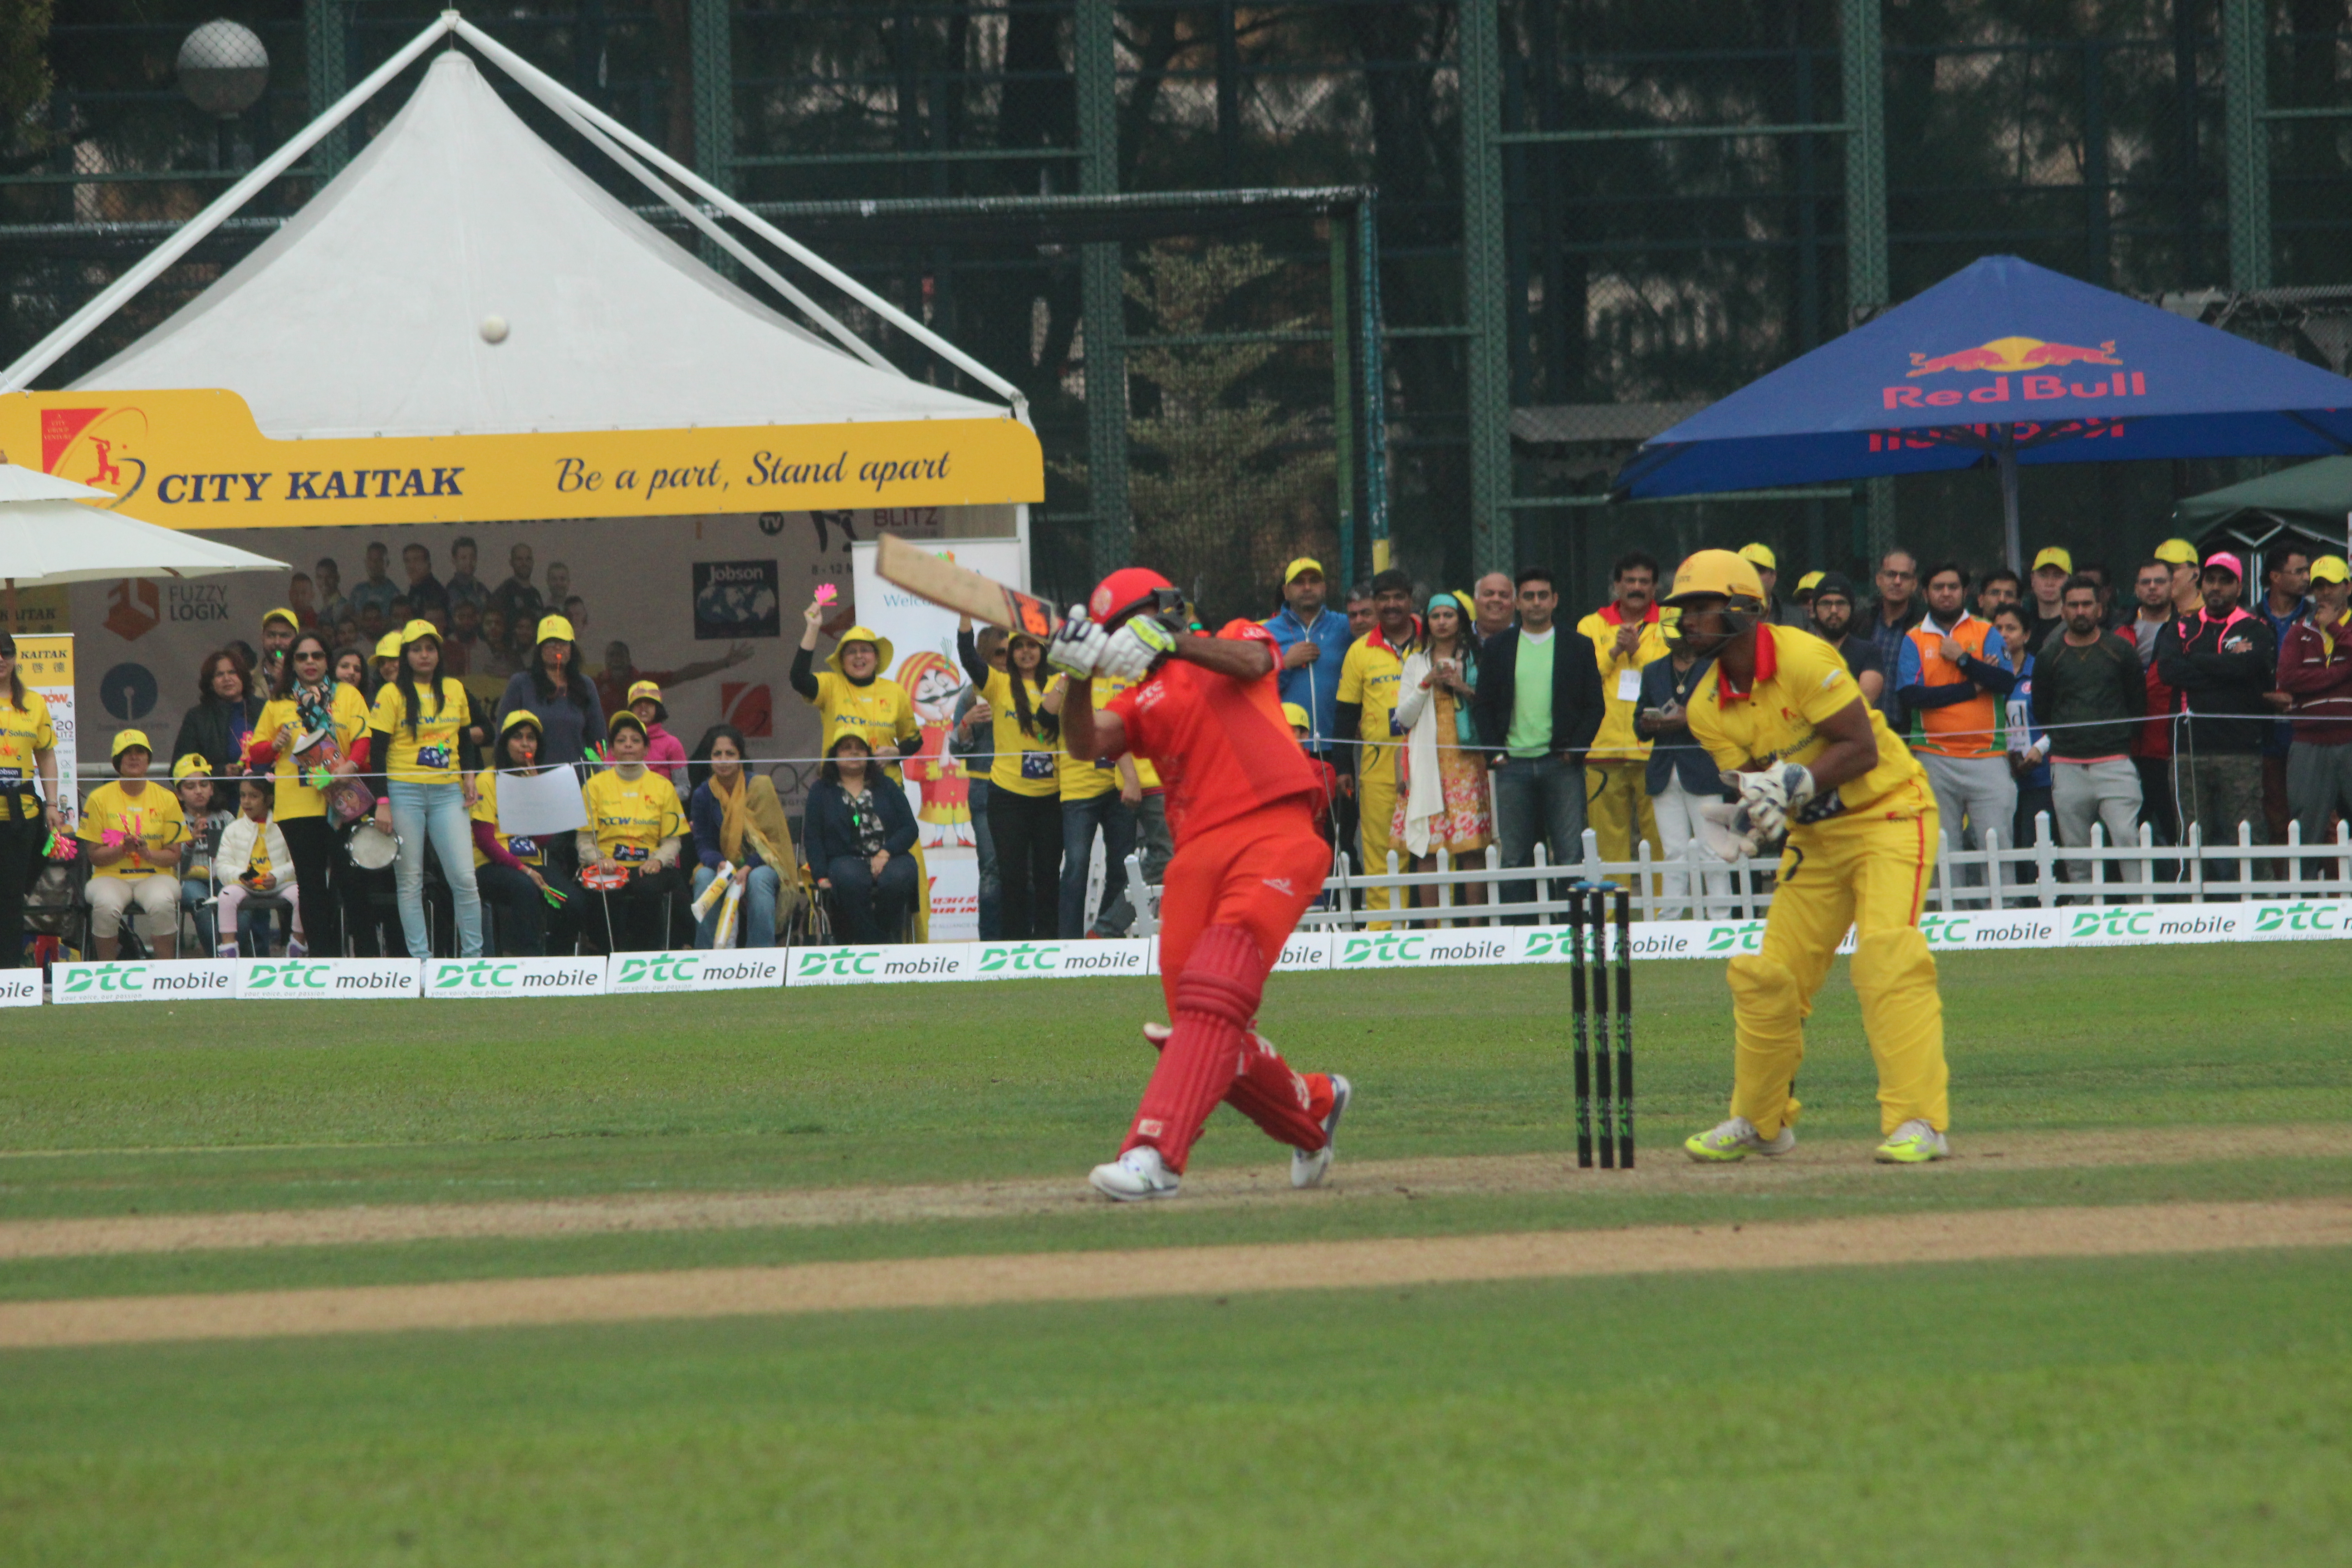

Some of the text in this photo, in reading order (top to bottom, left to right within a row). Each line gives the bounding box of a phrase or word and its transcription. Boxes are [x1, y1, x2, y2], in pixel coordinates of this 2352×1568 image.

[1883, 372, 2146, 409] Red Bull
[555, 450, 951, 500] Be a part, Stand apart
[157, 467, 465, 504] CITY KAITAK
[874, 507, 938, 527] BLITZ
[707, 565, 764, 585] Jobson
[170, 585, 226, 602] FUZZY
[884, 591, 935, 608] Welco
[170, 604, 228, 622] LOGIX
[21, 650, 67, 659] KAITAK
[1975, 923, 2052, 942] mobile
[2159, 917, 2235, 934] mobile
[1430, 941, 1505, 960] mobile
[884, 957, 959, 974] mobile
[1064, 952, 1139, 969] mobile
[336, 971, 412, 988] mobile
[522, 970, 598, 987] mobile
[703, 962, 776, 980] mobile
[152, 971, 229, 990] mobile
